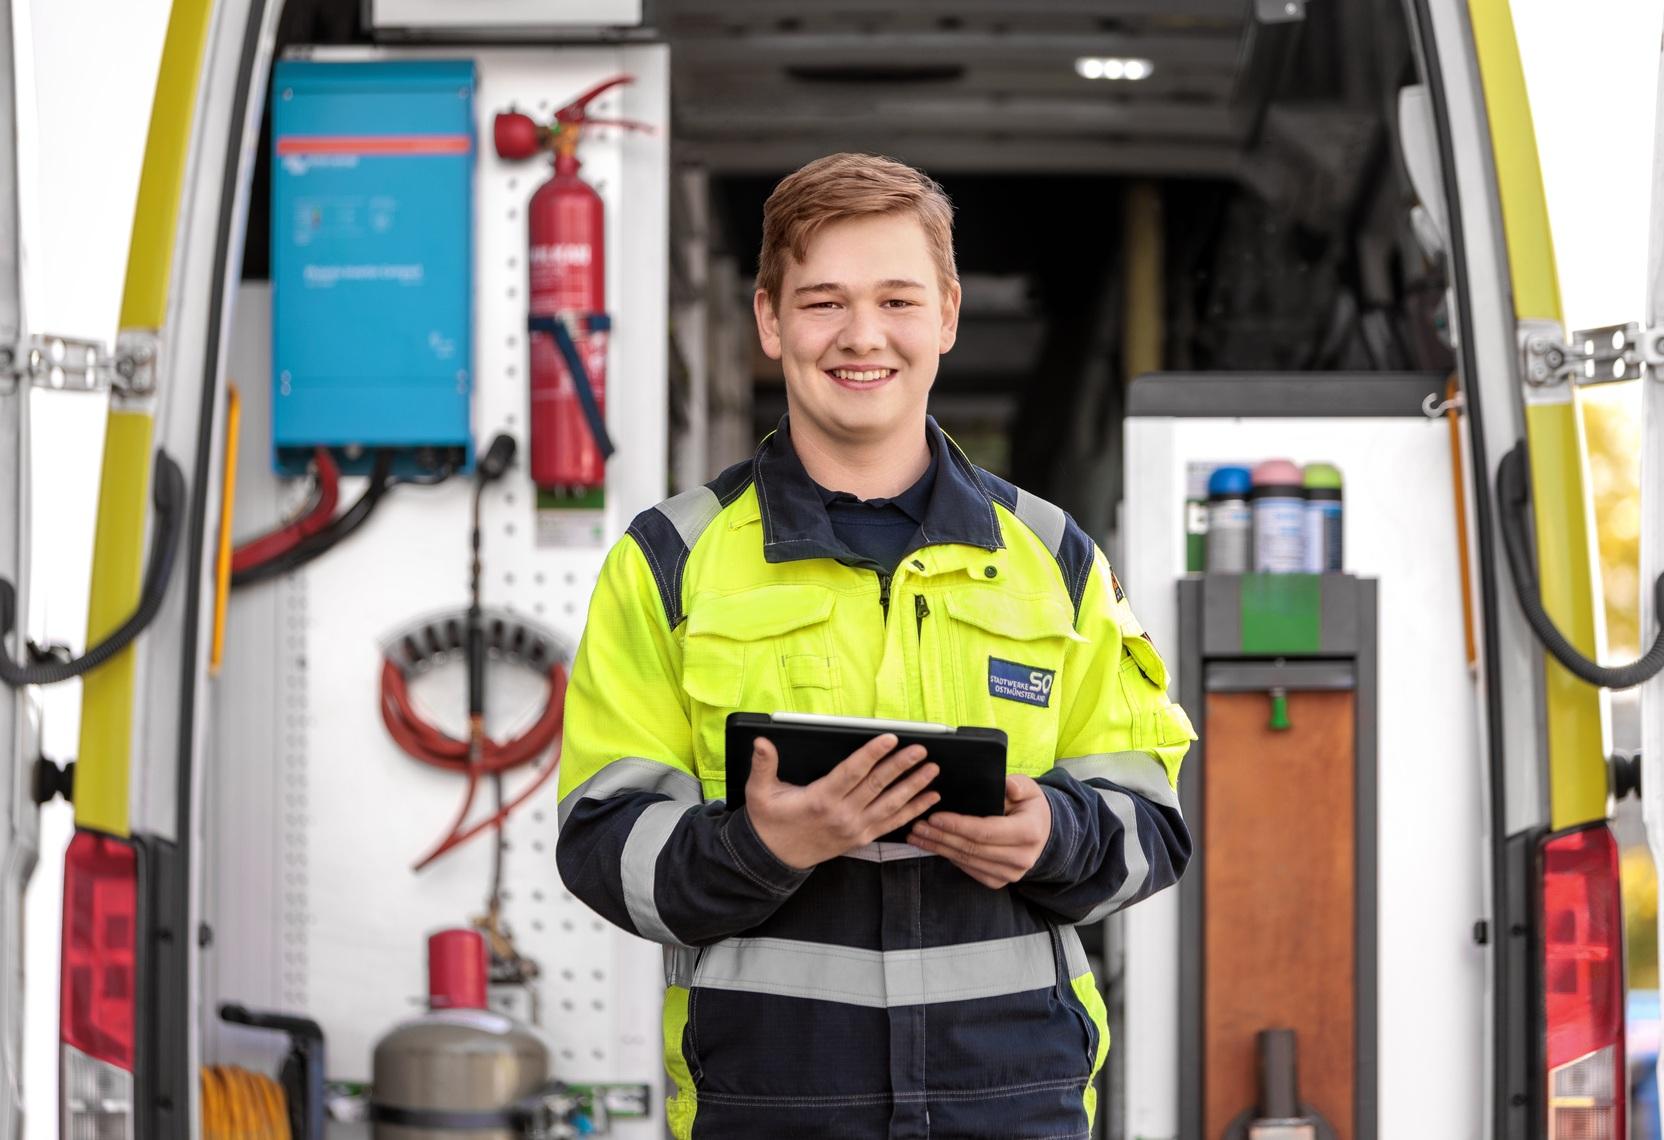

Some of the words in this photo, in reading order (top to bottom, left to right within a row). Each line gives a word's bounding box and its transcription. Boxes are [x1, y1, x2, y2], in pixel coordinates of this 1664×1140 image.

[990, 675, 1028, 690] STADTWERKE
[1029, 671, 1052, 694] SO
[995, 685, 1045, 702] OSTMÜNSTERLAND
